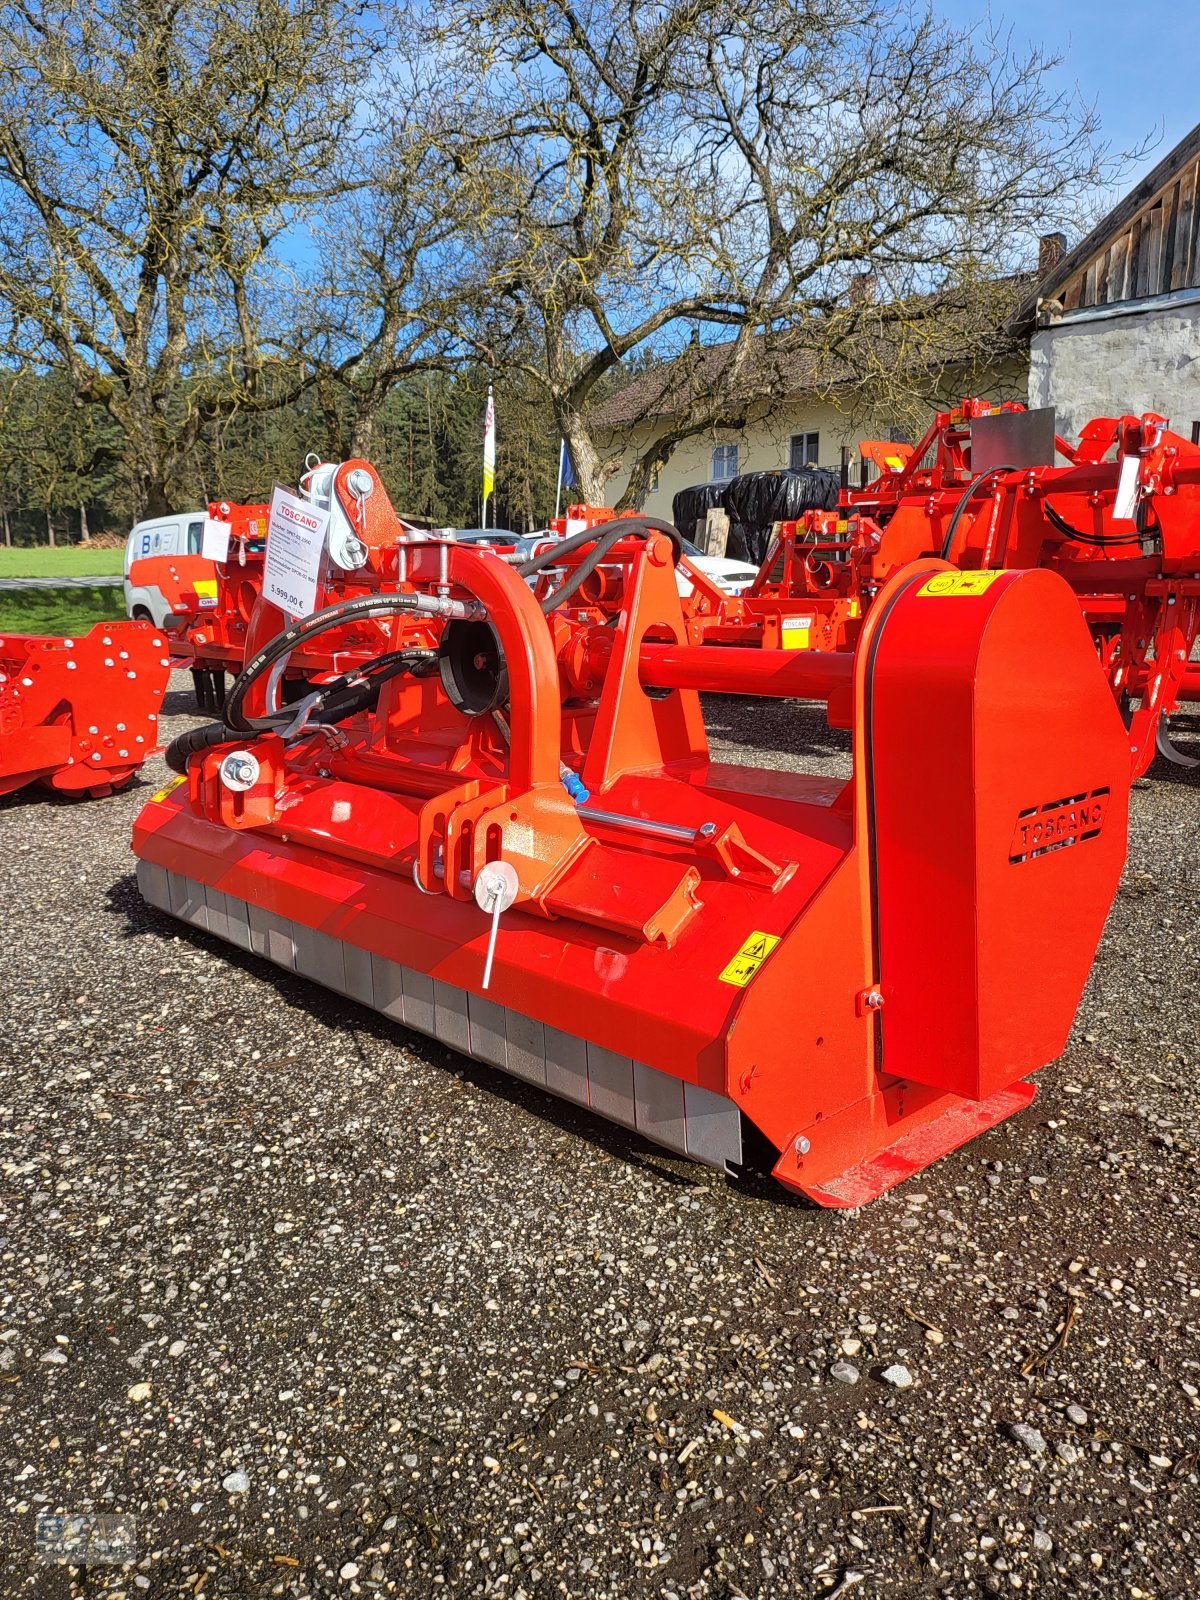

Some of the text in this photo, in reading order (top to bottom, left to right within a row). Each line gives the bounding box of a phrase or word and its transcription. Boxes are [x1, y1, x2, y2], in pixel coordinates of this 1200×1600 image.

[281, 505, 318, 529] TOSCANO
[271, 584, 304, 609] 5.999,00 €
[1020, 804, 1102, 846] TOSCANO
